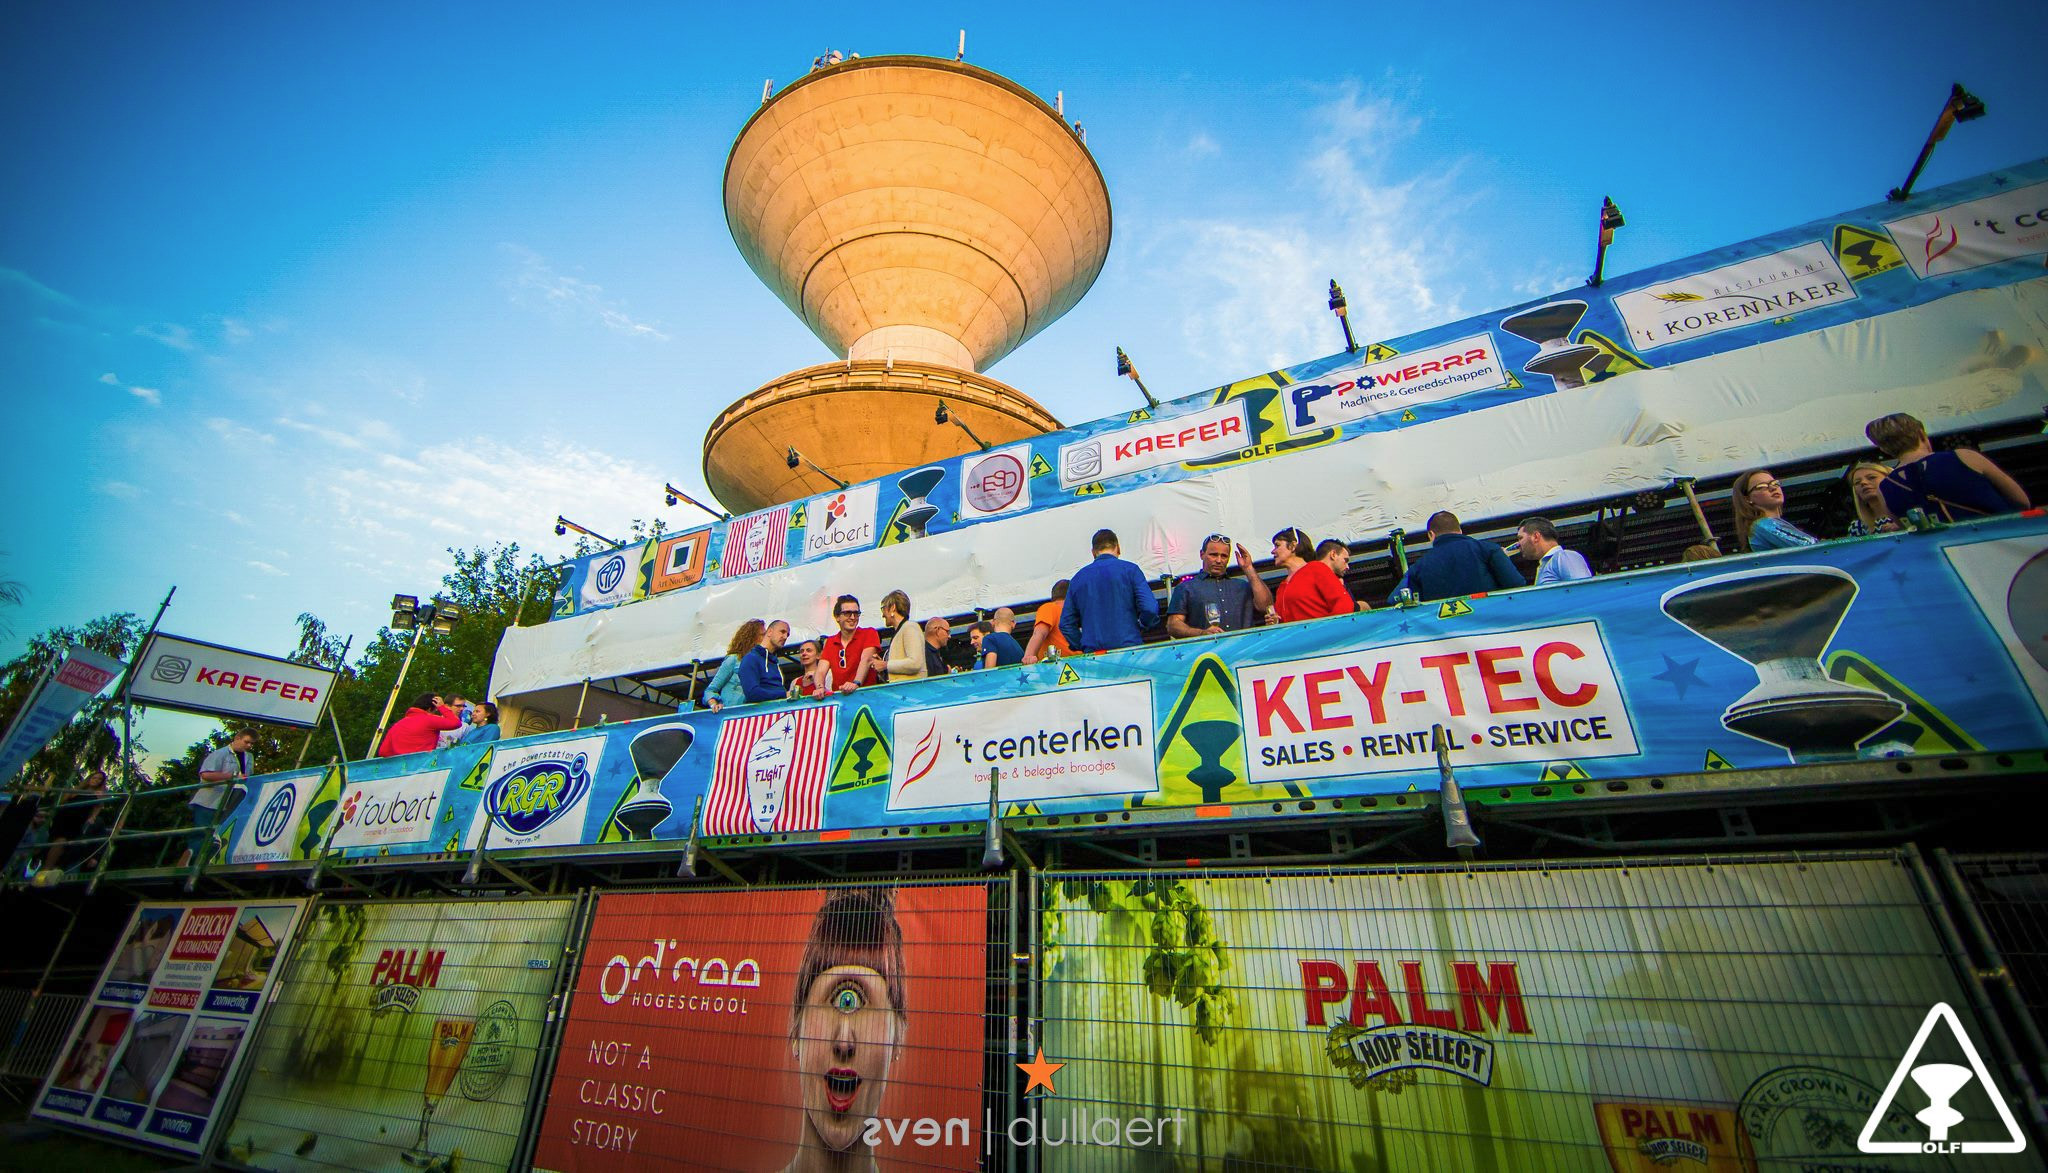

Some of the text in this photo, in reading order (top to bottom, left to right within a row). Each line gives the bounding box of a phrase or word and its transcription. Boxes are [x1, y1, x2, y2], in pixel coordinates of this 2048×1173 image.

[1713, 260, 1825, 296] RESTAURANT
[1664, 281, 1846, 336] KORENNAER
[1340, 391, 1389, 410] Machines
[1398, 365, 1493, 397] Gereedschappen
[1115, 415, 1242, 462] KAEFER
[1241, 443, 1276, 460] OLF
[808, 522, 870, 551] foubert
[195, 666, 319, 704] KAEFER
[1252, 641, 1600, 738] KEY-TEC
[982, 719, 1143, 762] centerken
[1261, 740, 1336, 767] SALES
[1490, 716, 1613, 749] SERVICE
[502, 750, 574, 772] the powerstation
[1011, 767, 1019, 779] &
[1024, 763, 1065, 780] belegde
[1070, 760, 1116, 775] broodjes
[498, 771, 567, 815] RGR
[854, 778, 873, 788] OLF
[355, 790, 437, 828] foubert
[183, 914, 233, 936] DIERICKX
[369, 949, 447, 988] PALM
[211, 995, 250, 1011] zonwering
[631, 991, 749, 1015] HOGESCHOOL
[1297, 959, 1533, 1035] PALM
[588, 1039, 651, 1070] NOT A
[1358, 1031, 1487, 1075] HOP SELECT
[580, 1079, 666, 1115] CLASSIC
[1779, 1078, 1849, 1097] GROWN
[571, 1118, 639, 1154] STORY
[1620, 1107, 1723, 1145] PALM
